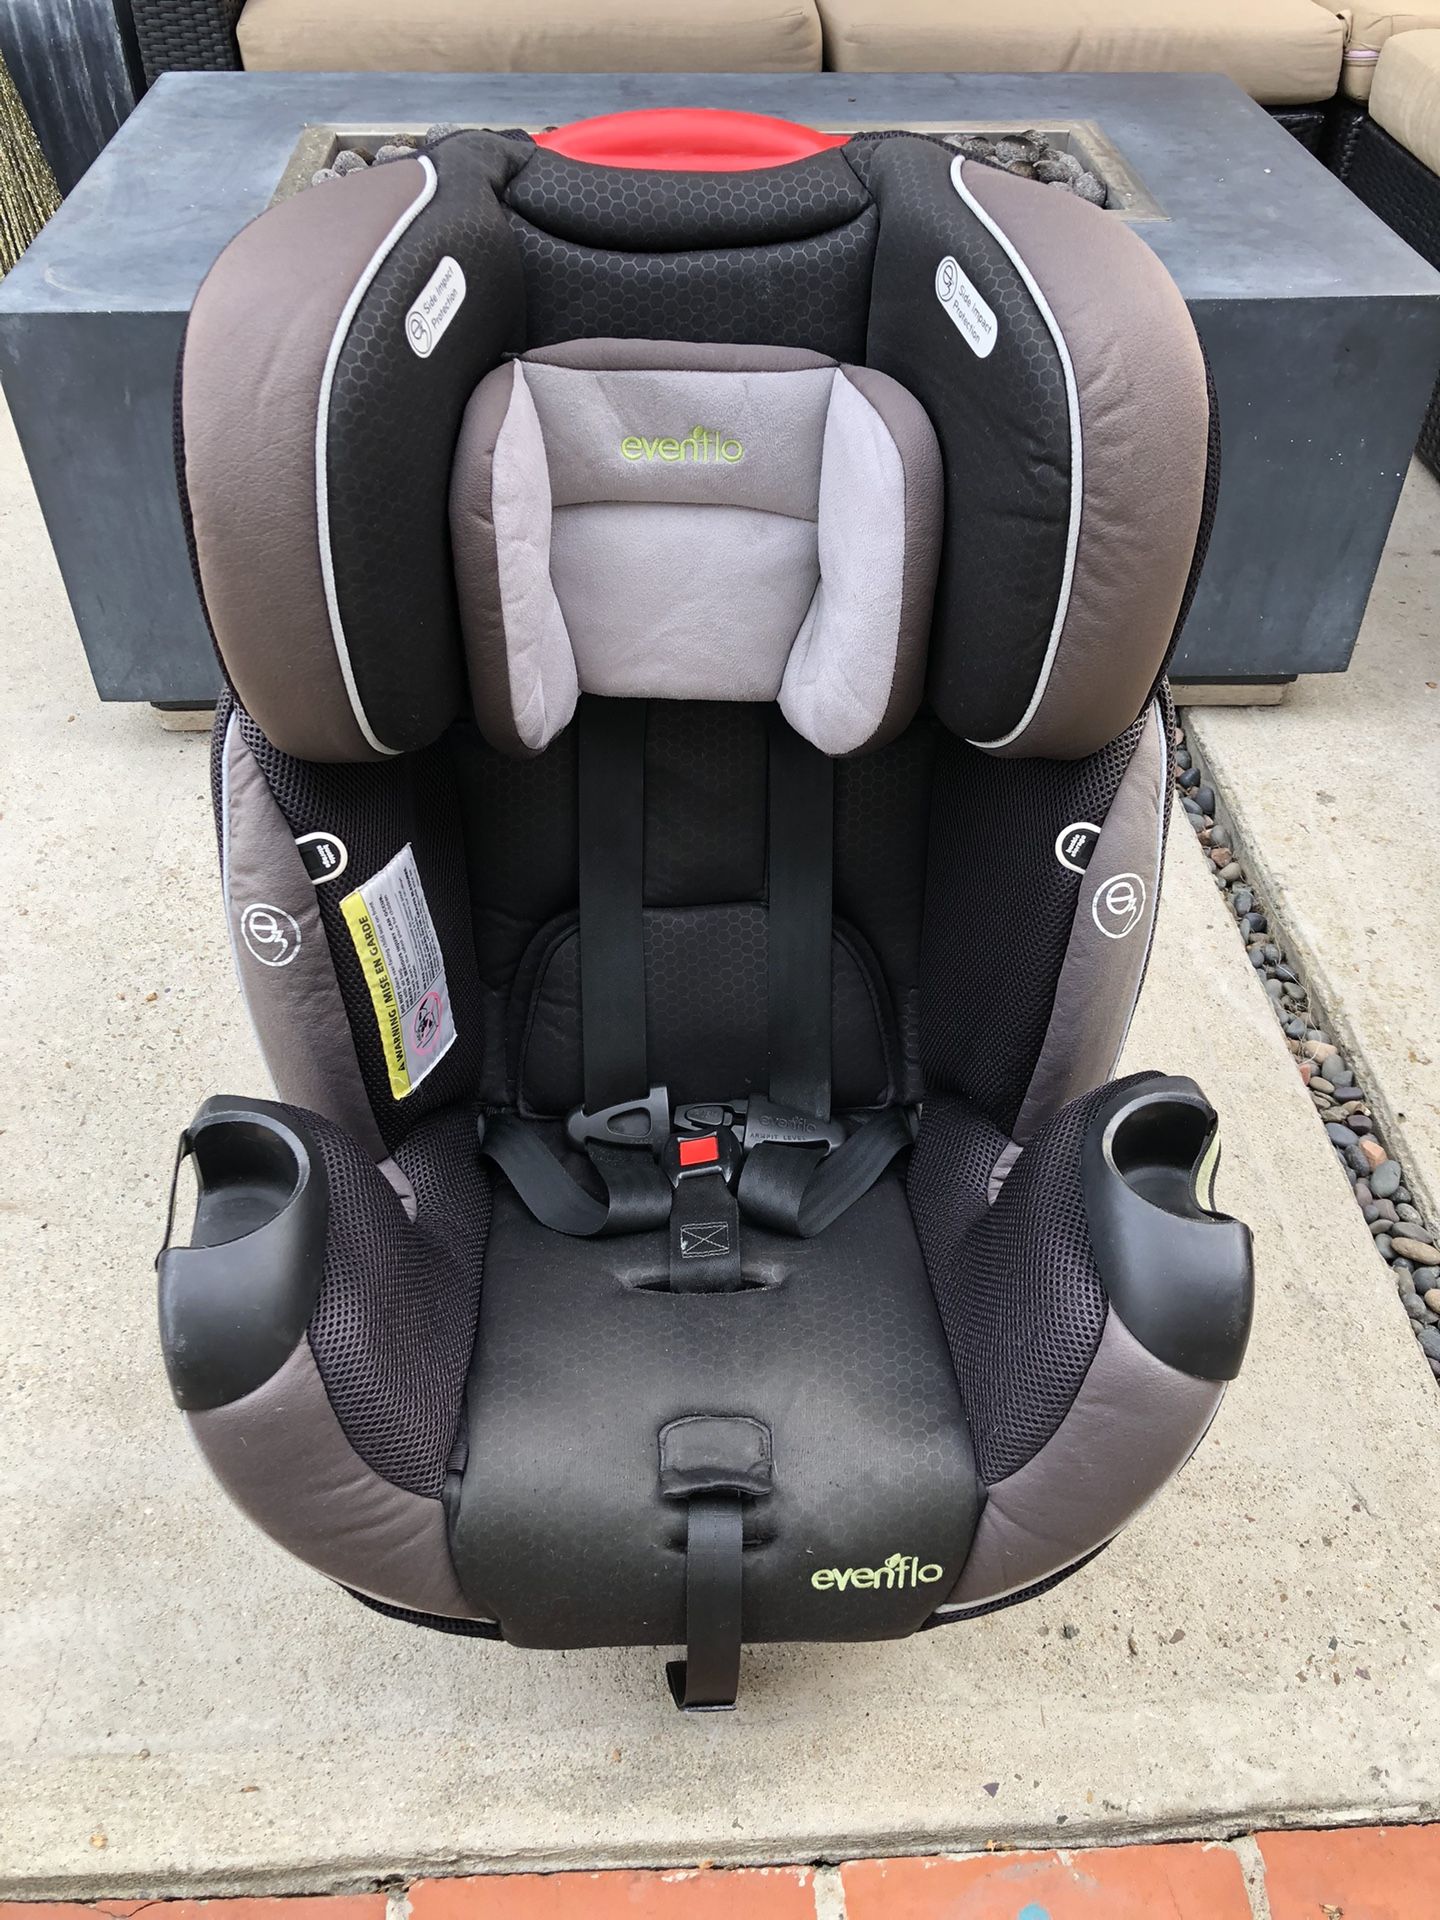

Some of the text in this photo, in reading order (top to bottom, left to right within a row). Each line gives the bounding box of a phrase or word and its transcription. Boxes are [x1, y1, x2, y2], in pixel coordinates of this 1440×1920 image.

[423, 266, 454, 314] Side Impact
[431, 288, 458, 329] Protection
[958, 285, 992, 334] Side Impact
[952, 300, 980, 343] Protection
[621, 425, 744, 463] evenflo
[358, 915, 379, 956] GARDE
[373, 958, 388, 975] EN
[379, 974, 394, 1003] MISE
[388, 1011, 403, 1063] WARNING
[811, 1553, 943, 1591] evenflo
